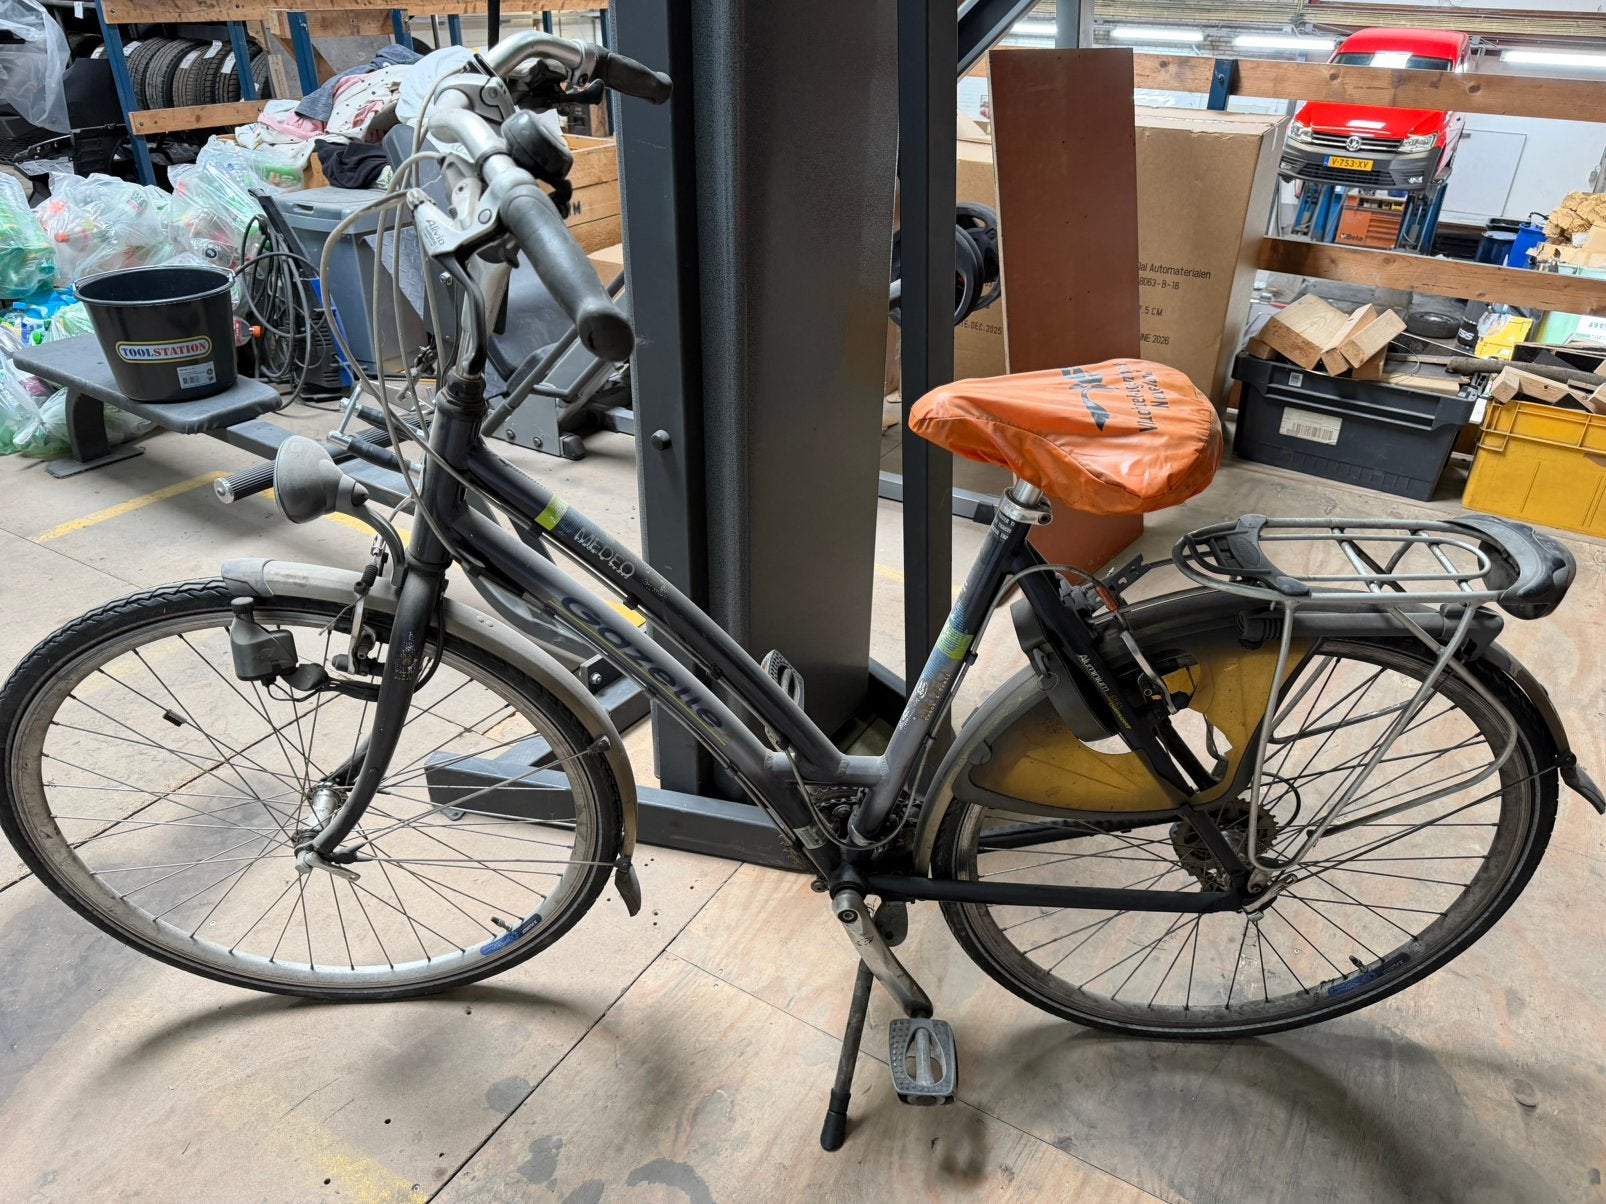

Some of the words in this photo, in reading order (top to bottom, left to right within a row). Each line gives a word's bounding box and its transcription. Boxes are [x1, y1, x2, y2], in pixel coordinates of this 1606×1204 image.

[426, 219, 445, 246] Alivio
[1149, 263, 1211, 280] Automaterialen
[120, 341, 207, 357] TOOLSTATION
[574, 527, 635, 577] MEDEO
[561, 597, 723, 729] Gazelle
[1078, 653, 1110, 693] Aluminium
